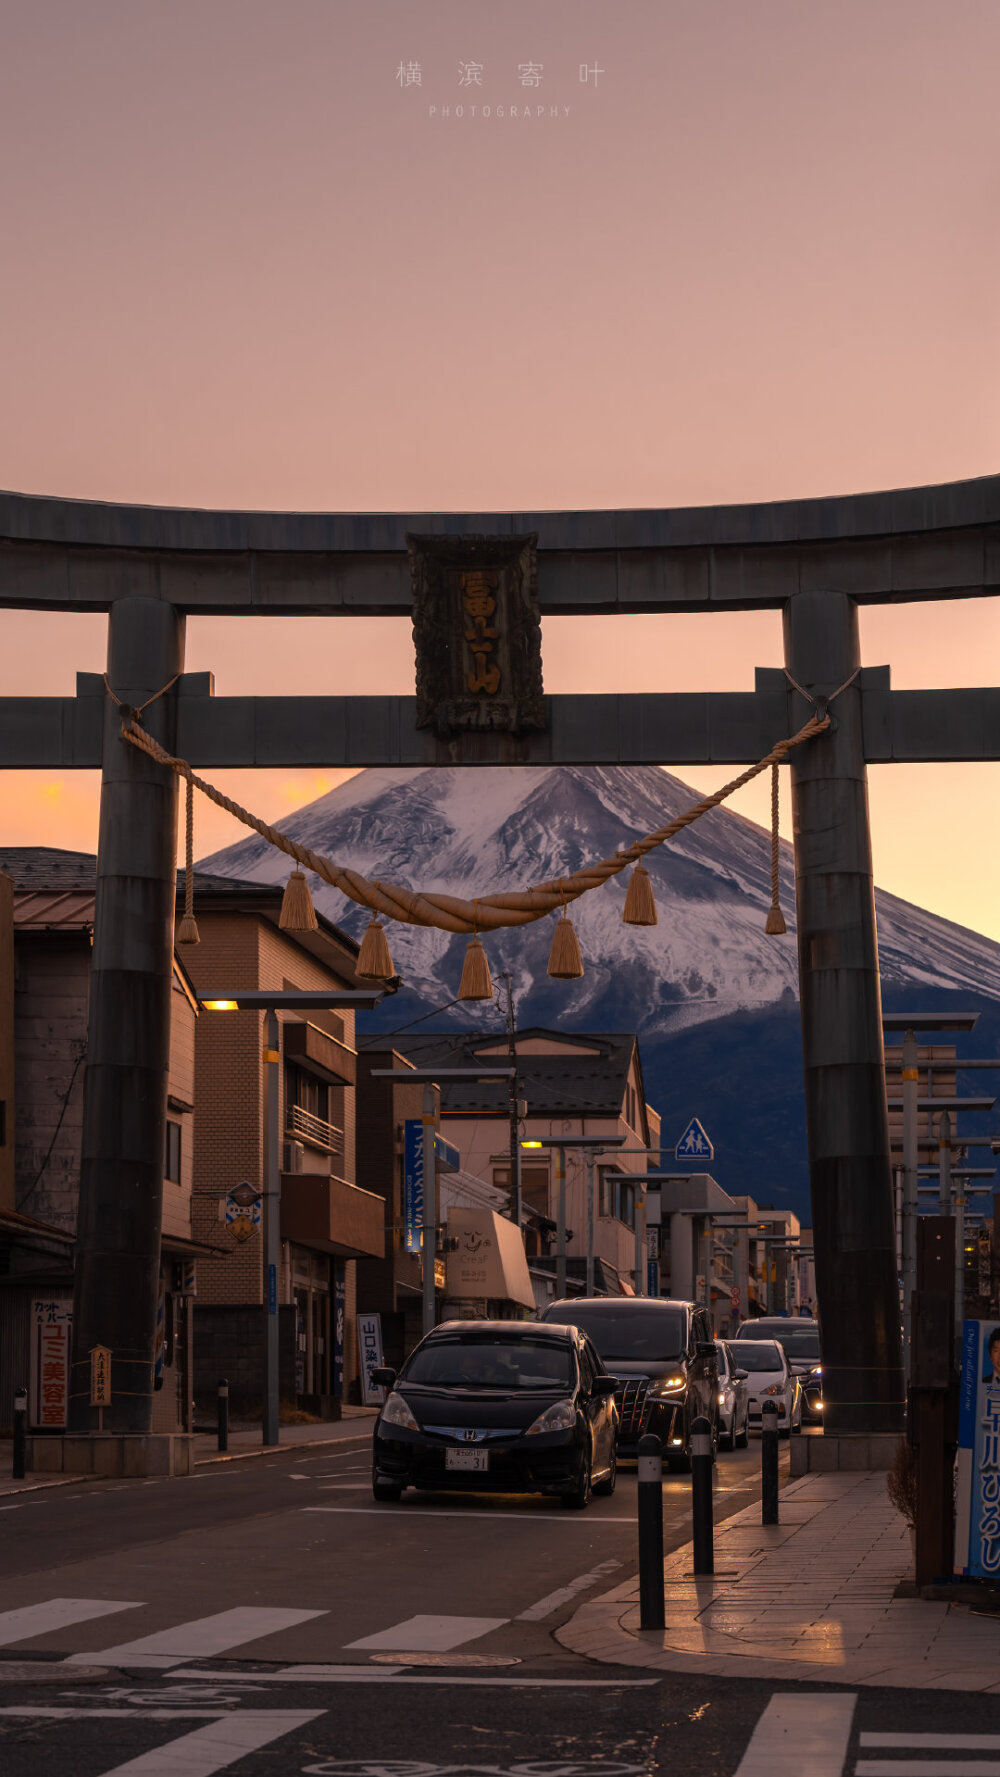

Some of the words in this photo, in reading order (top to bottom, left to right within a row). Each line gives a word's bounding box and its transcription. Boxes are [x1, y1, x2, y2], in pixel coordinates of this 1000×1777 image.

[35, 1302, 59, 1312] カット
[42, 1324, 66, 1424] ユミ美容室
